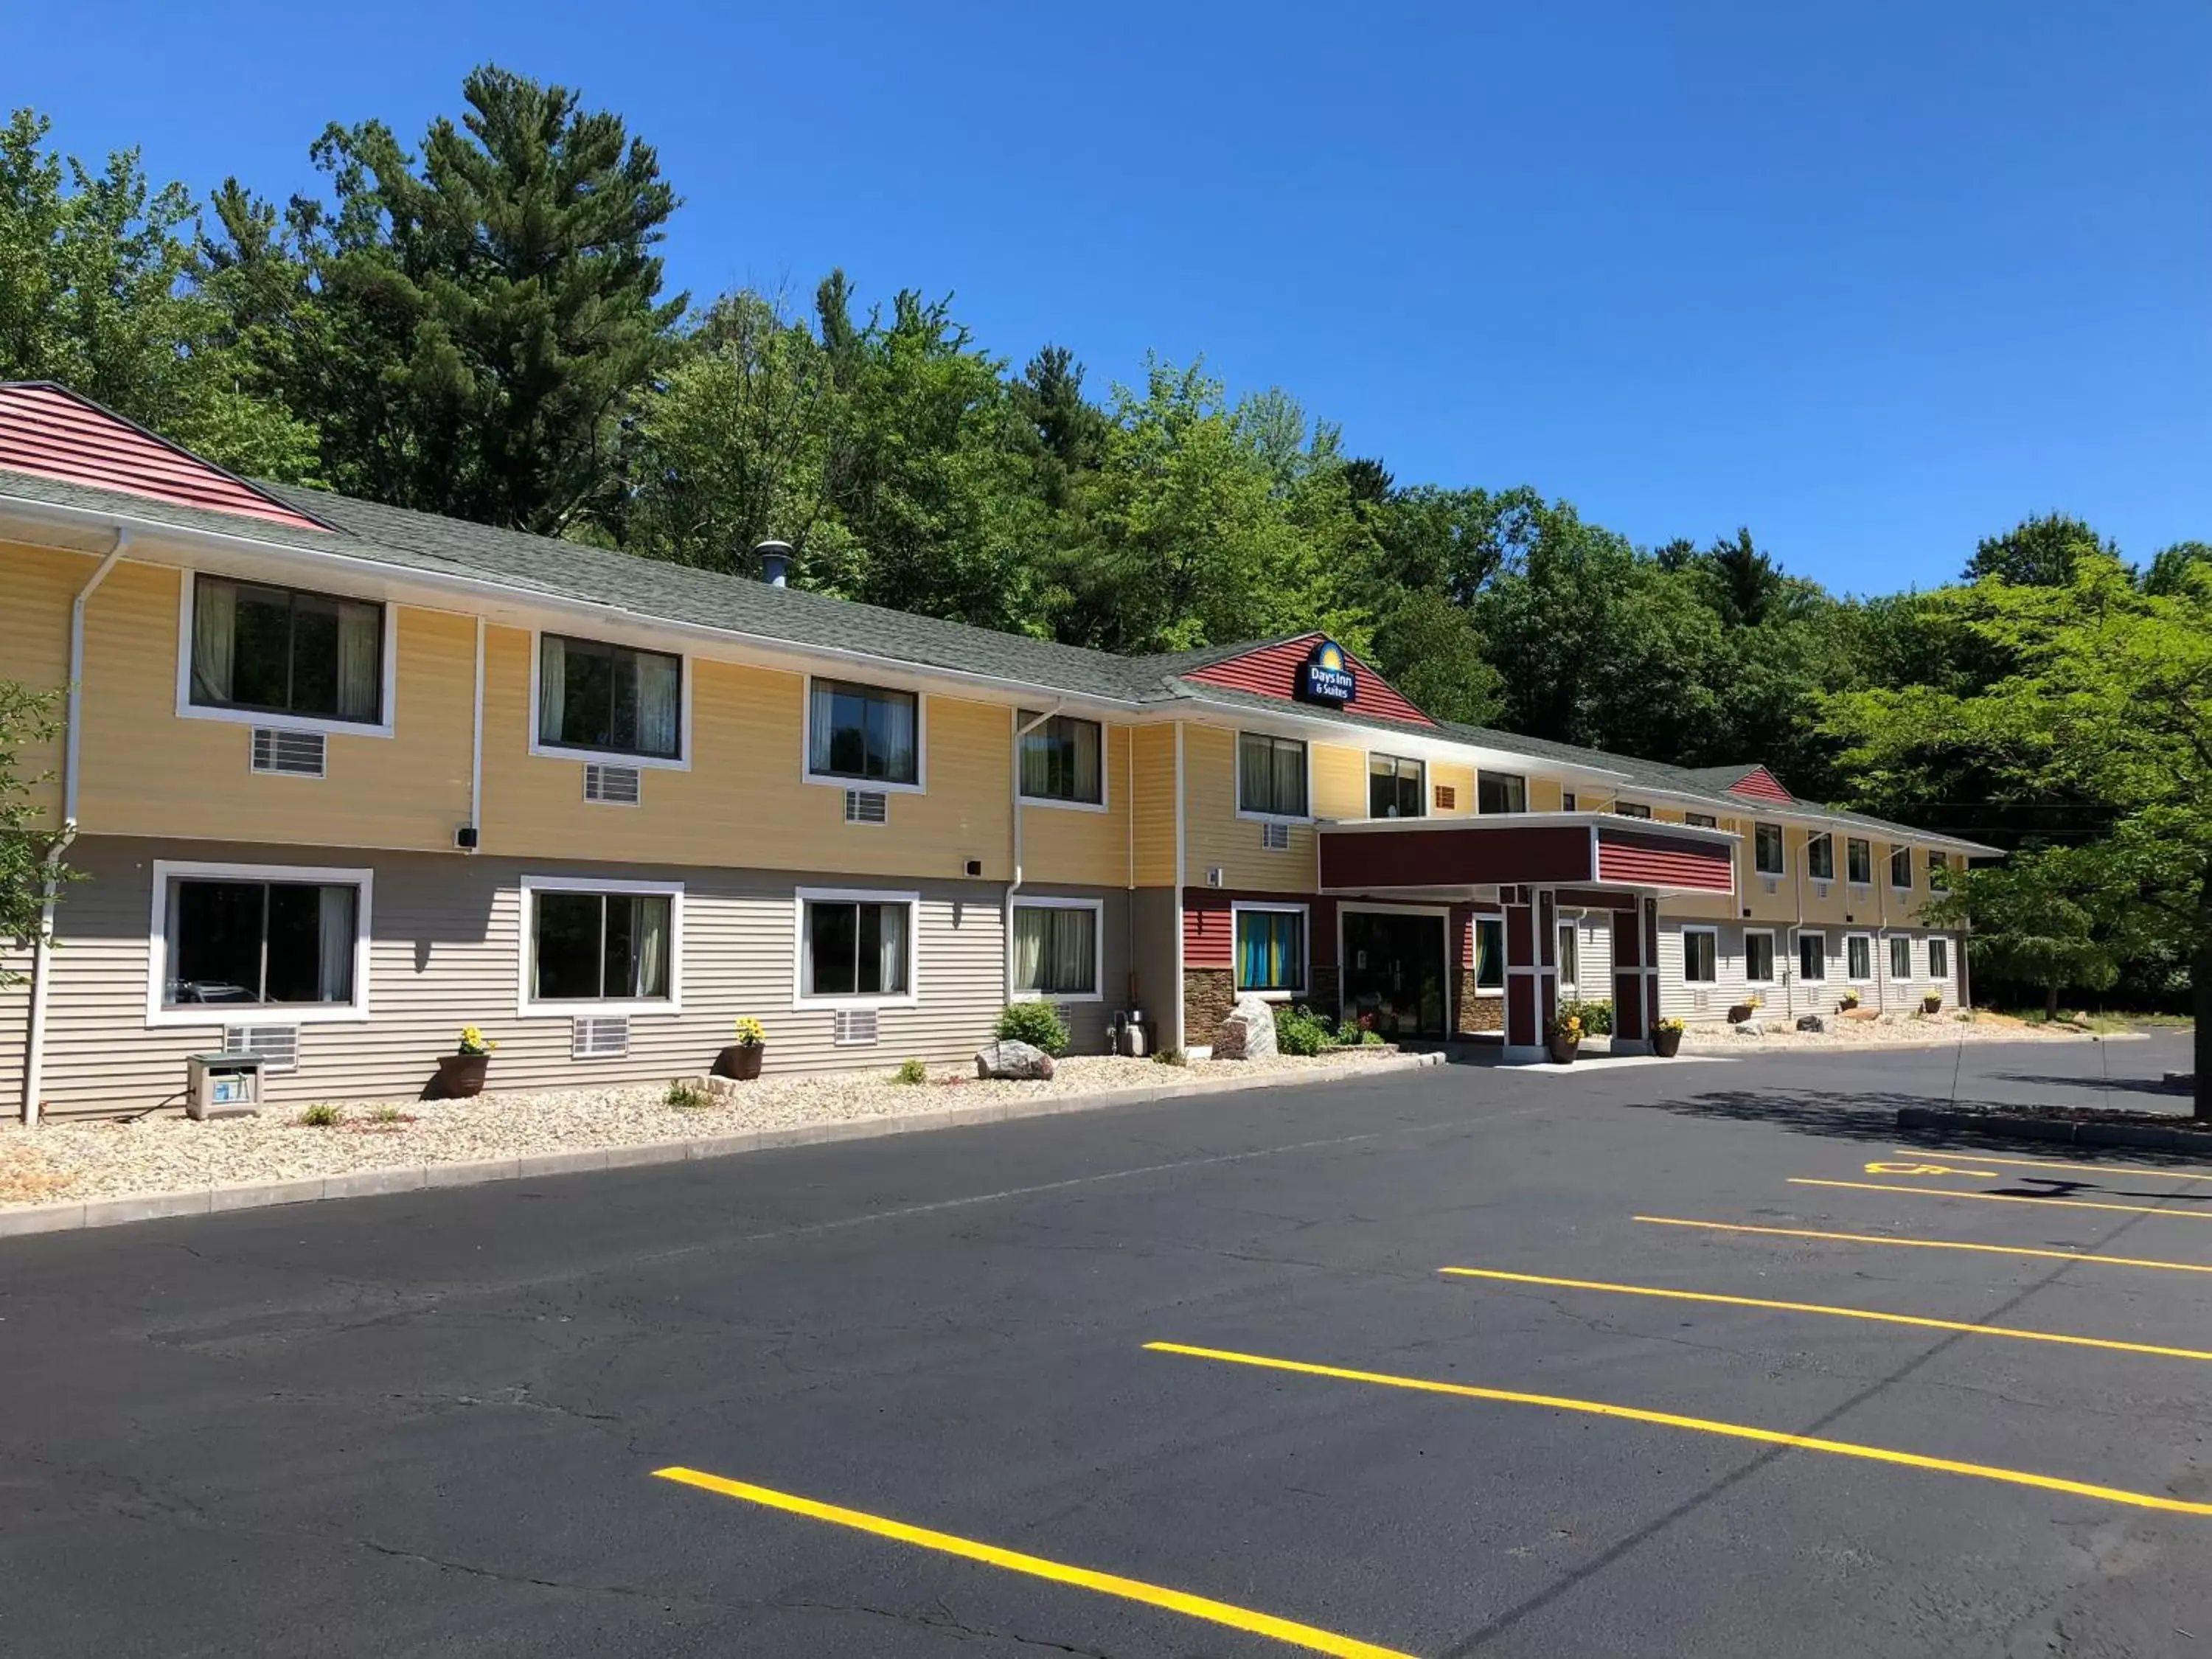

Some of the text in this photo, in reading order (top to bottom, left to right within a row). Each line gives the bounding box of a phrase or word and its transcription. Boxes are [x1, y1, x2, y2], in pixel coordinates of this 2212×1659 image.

[1312, 667, 1352, 686] Days Inn
[1316, 683, 1348, 698] & Suites
